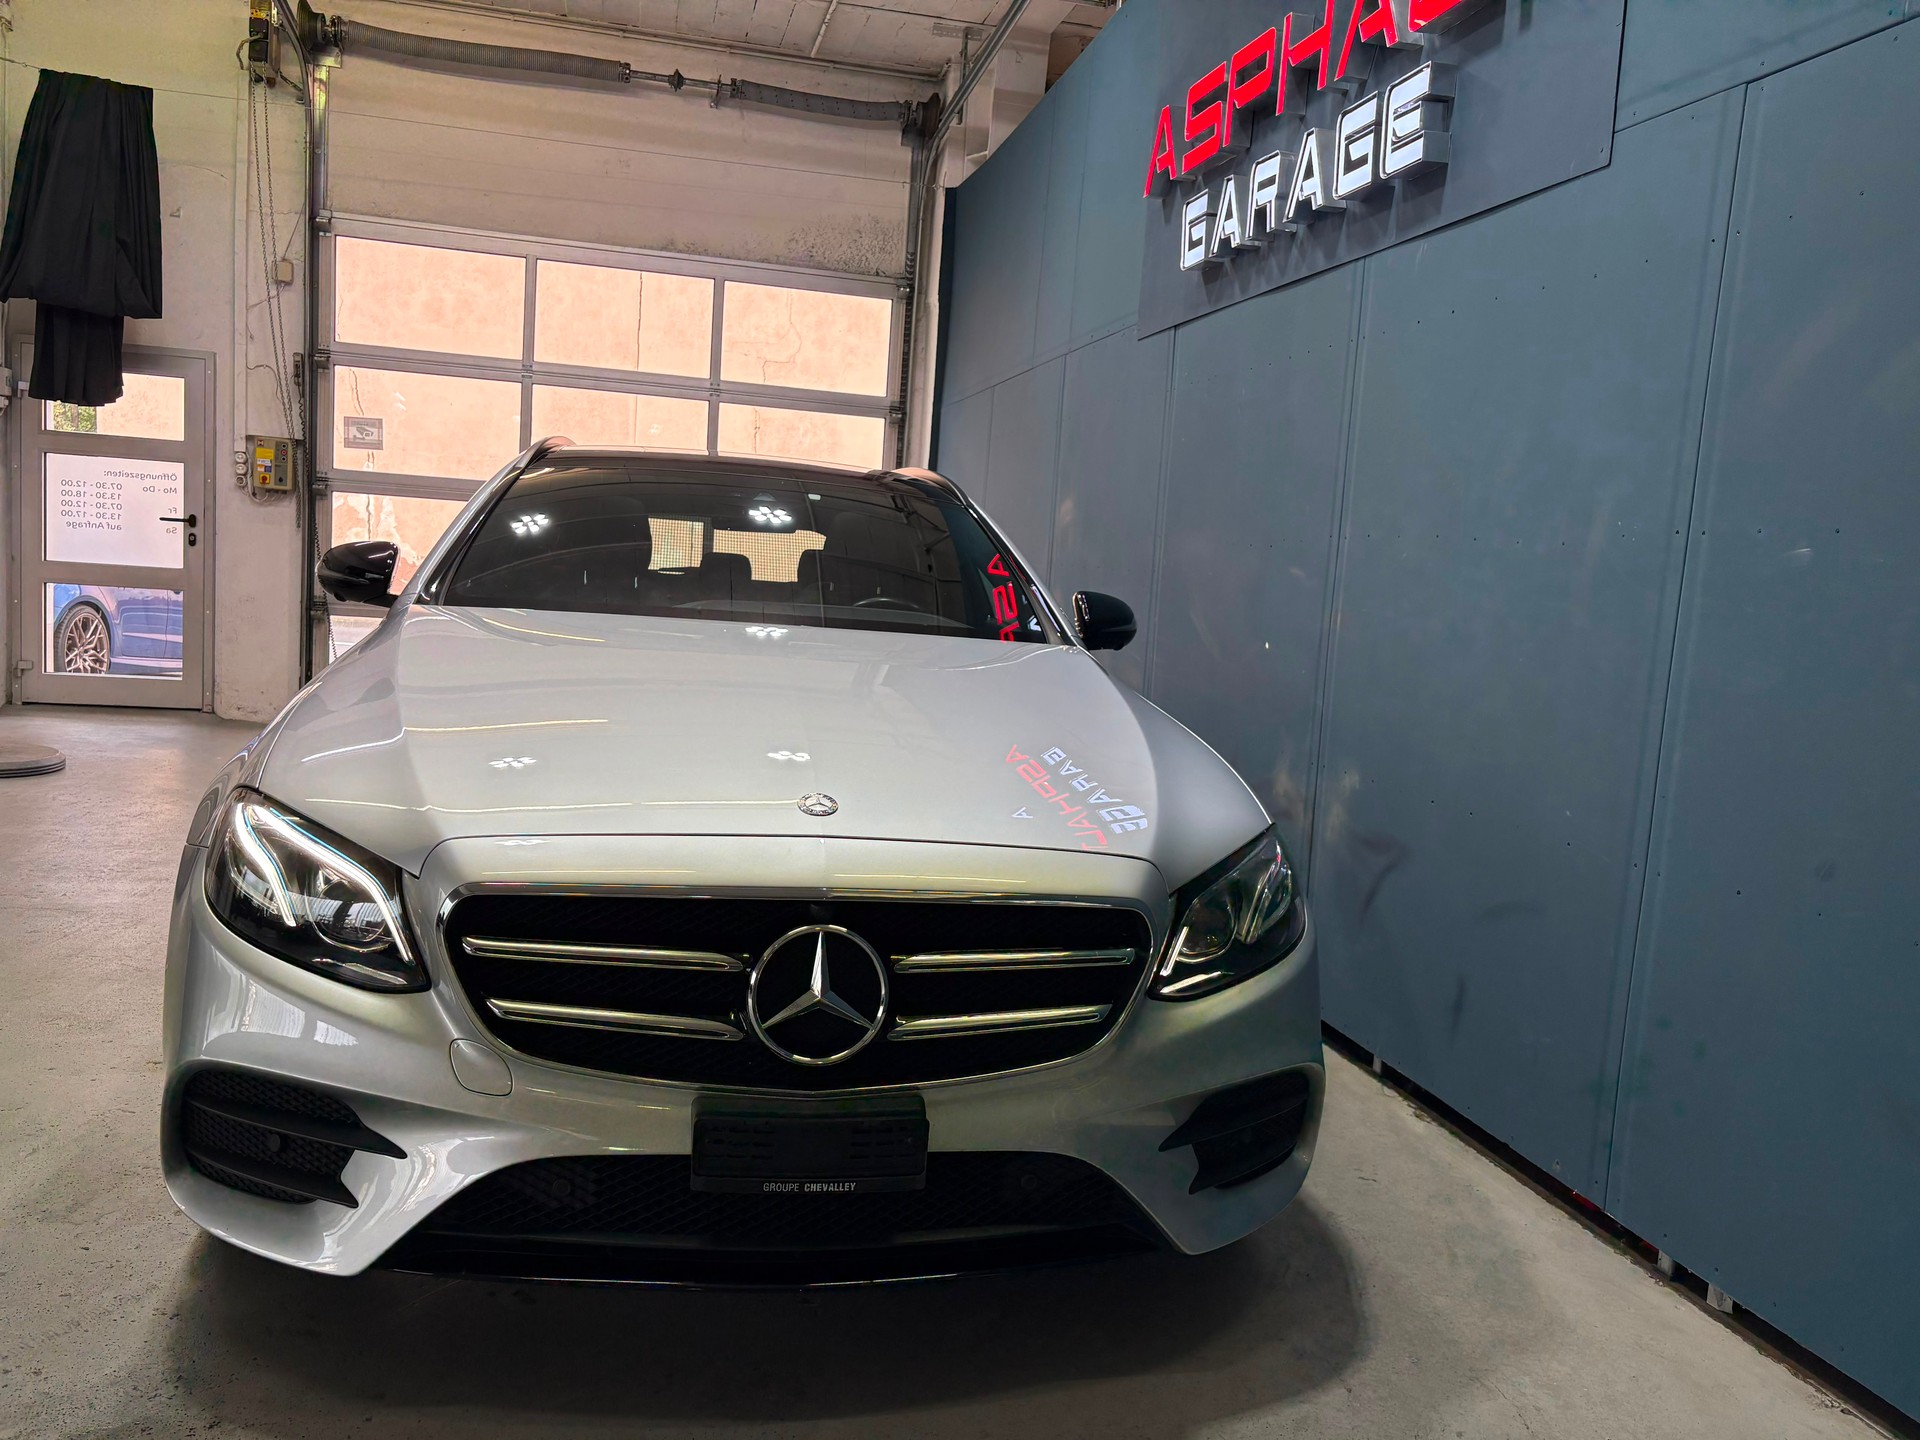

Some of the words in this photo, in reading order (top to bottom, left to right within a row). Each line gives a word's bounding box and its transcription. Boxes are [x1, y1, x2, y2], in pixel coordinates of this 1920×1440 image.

[1143, 0, 1463, 198] ASPHA
[1180, 61, 1432, 271] GARAGE
[763, 1182, 800, 1192] GROUPE
[804, 1182, 856, 1192] CHEVALLEY
